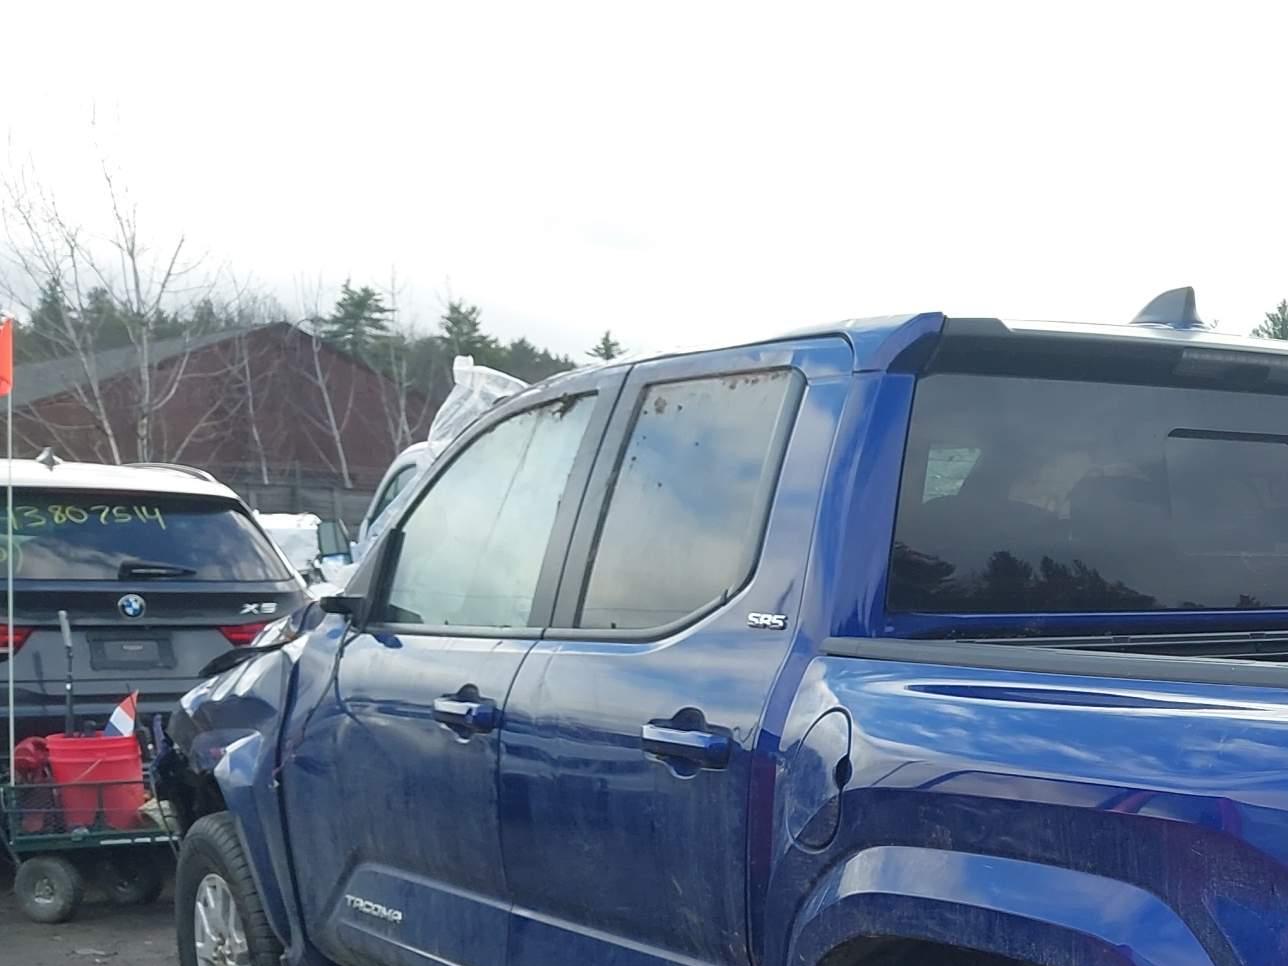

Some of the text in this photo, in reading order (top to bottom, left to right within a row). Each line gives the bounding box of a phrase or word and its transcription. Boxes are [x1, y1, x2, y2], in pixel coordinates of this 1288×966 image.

[239, 602, 278, 615] X5
[747, 612, 787, 630] SR5
[344, 894, 403, 925] TACOMA
